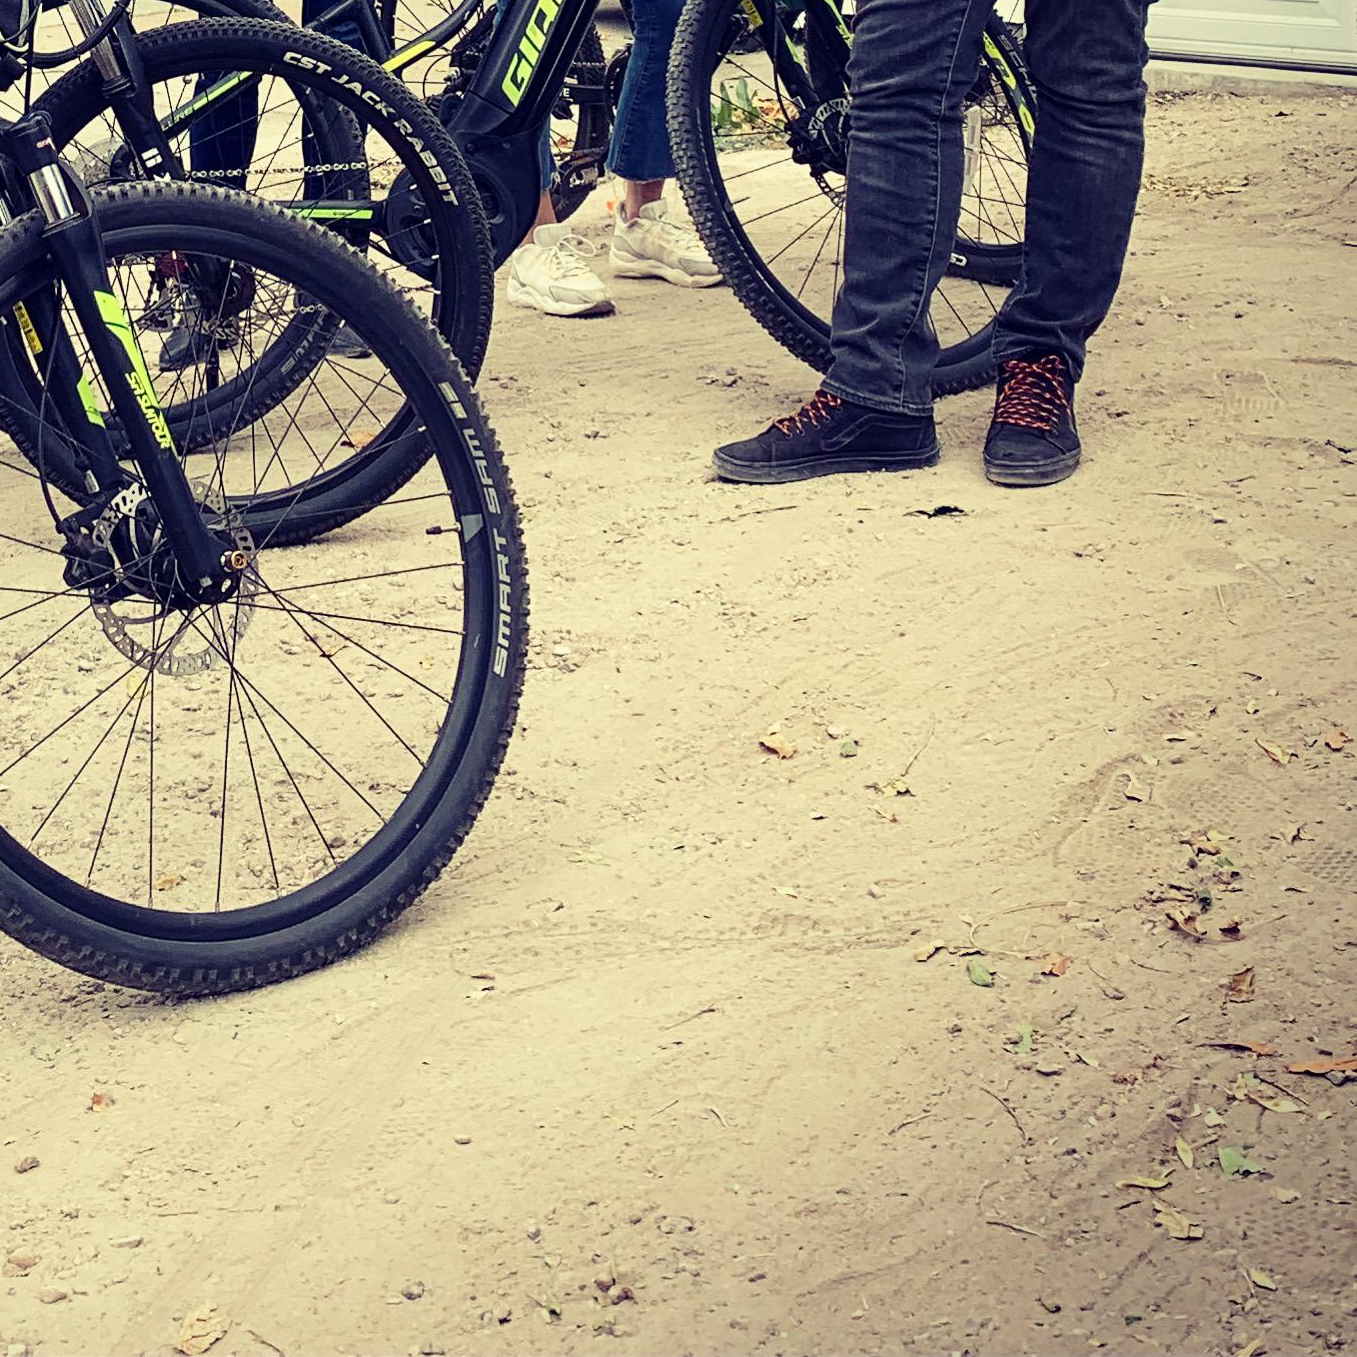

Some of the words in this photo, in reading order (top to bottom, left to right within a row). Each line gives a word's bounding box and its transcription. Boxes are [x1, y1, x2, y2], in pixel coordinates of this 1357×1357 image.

[282, 51, 333, 75] CST
[331, 74, 396, 118] JACK
[394, 118, 459, 206] RABBIT
[137, 394, 171, 450] SUNTOUR
[463, 428, 501, 515] SAM
[493, 527, 513, 678] SMART
